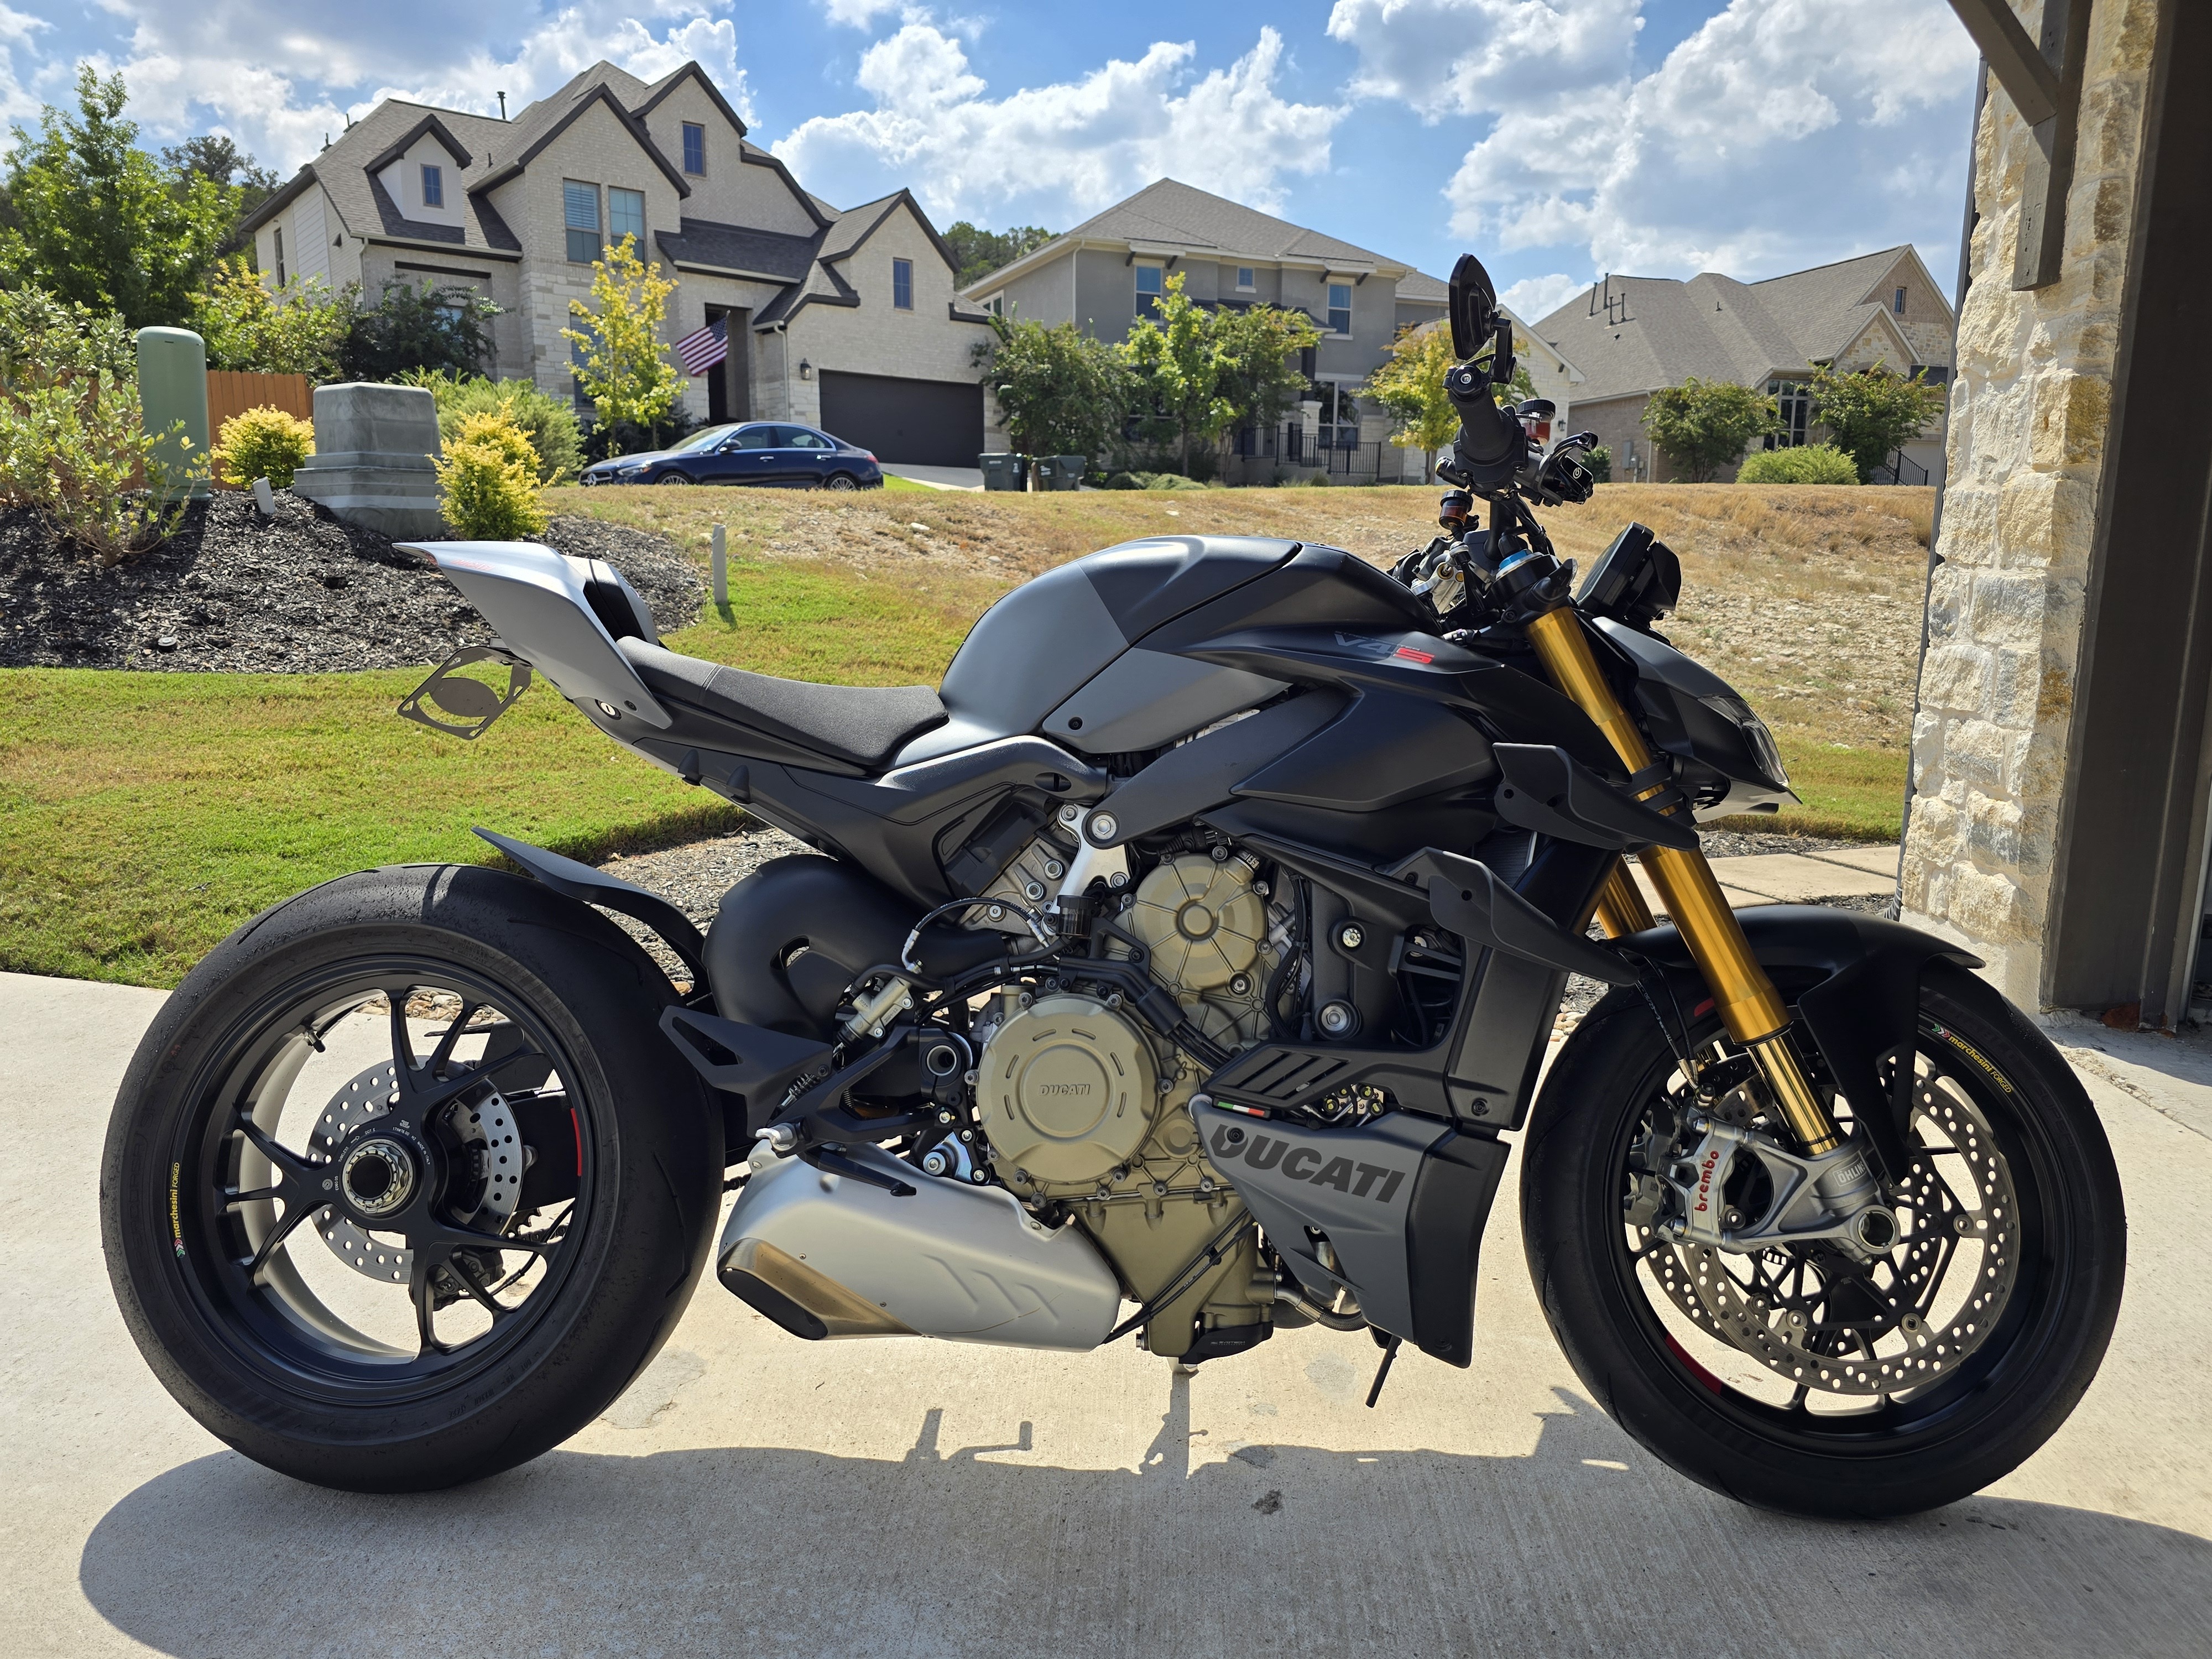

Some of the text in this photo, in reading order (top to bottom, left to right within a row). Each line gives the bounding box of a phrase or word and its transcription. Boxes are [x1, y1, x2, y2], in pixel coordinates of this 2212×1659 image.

[1040, 1084, 1090, 1095] DUCATI
[1948, 1036, 2012, 1093] marchesini FORGED
[1210, 1124, 1406, 1203] DUCATI
[1694, 1150, 1719, 1212] brembo
[170, 1189, 181, 1238] marchesini
